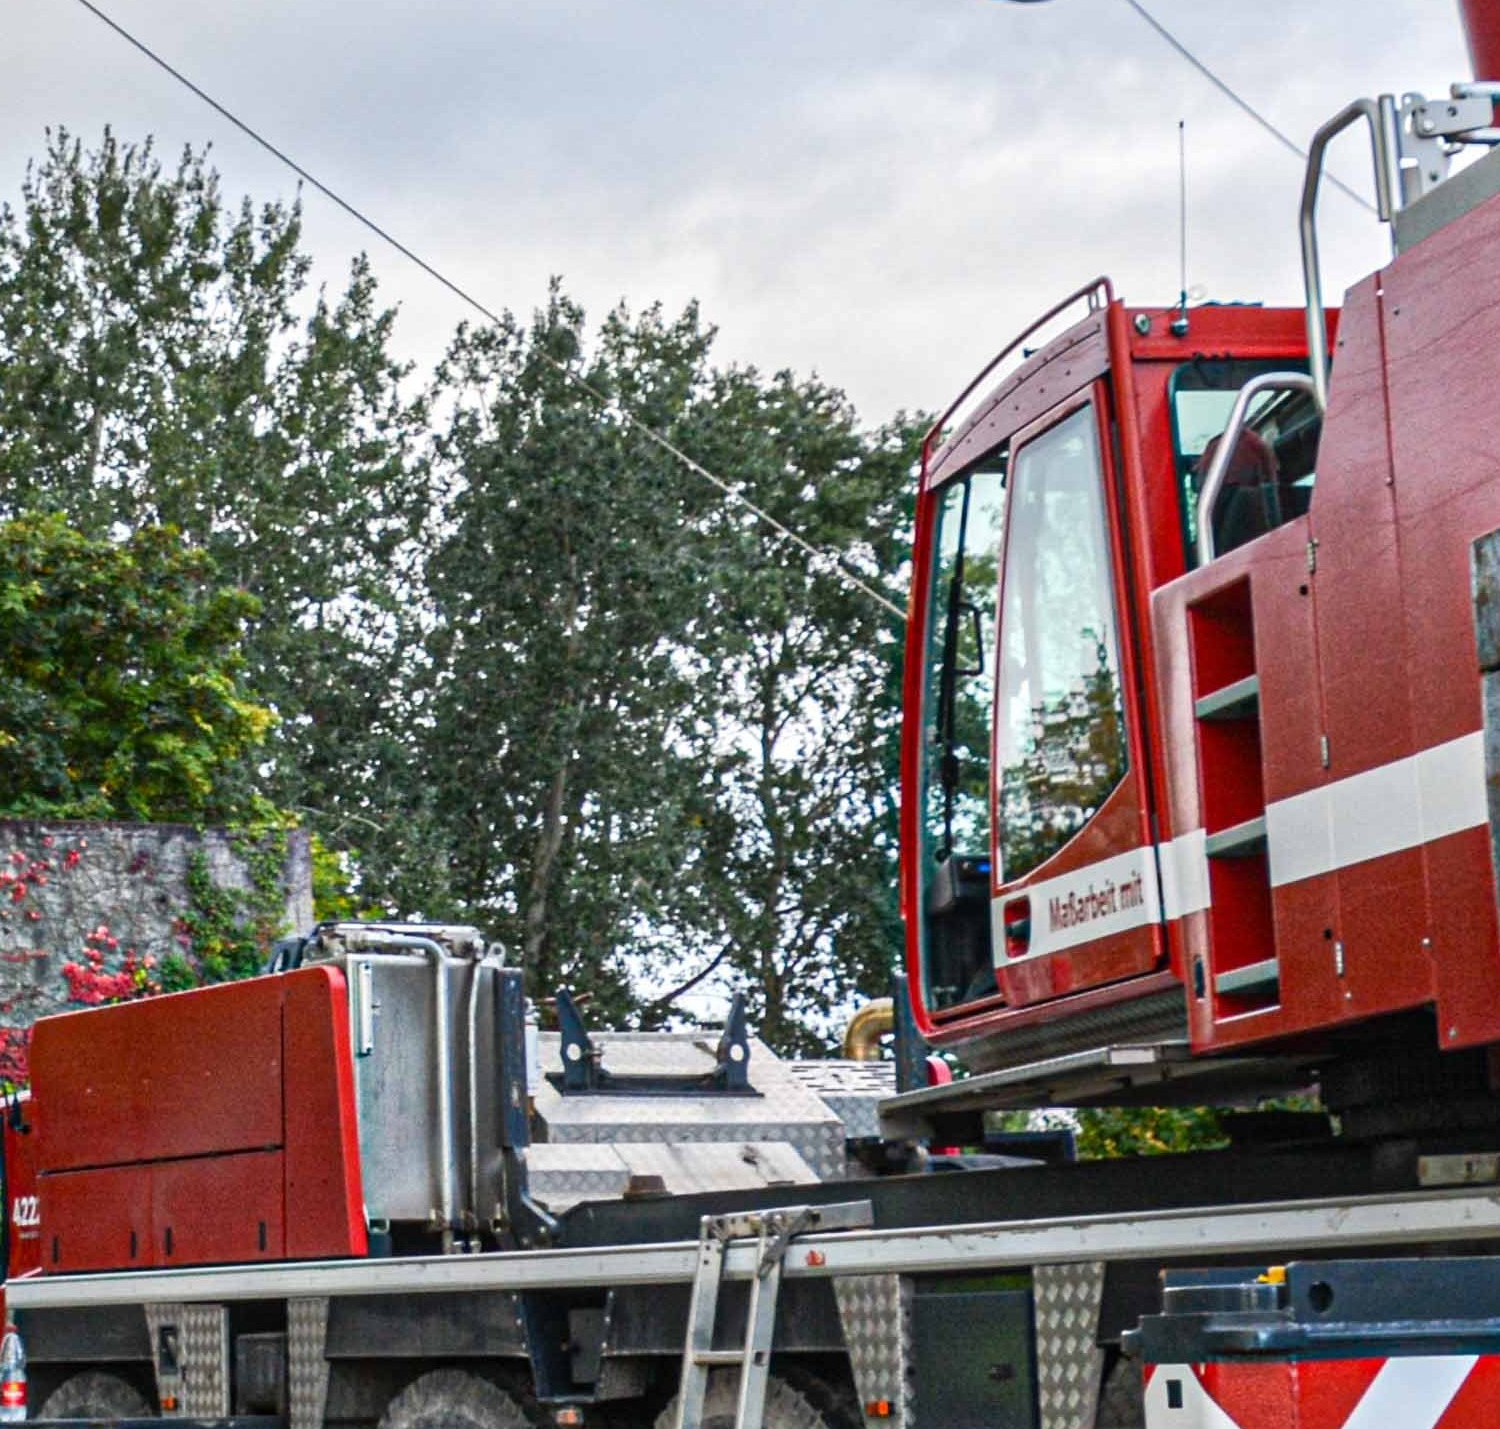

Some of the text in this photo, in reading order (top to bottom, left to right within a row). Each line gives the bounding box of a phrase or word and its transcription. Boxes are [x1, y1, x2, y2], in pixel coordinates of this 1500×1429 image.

[1049, 870, 1144, 933] Maßarbeit mit
[13, 1195, 41, 1226] 422
